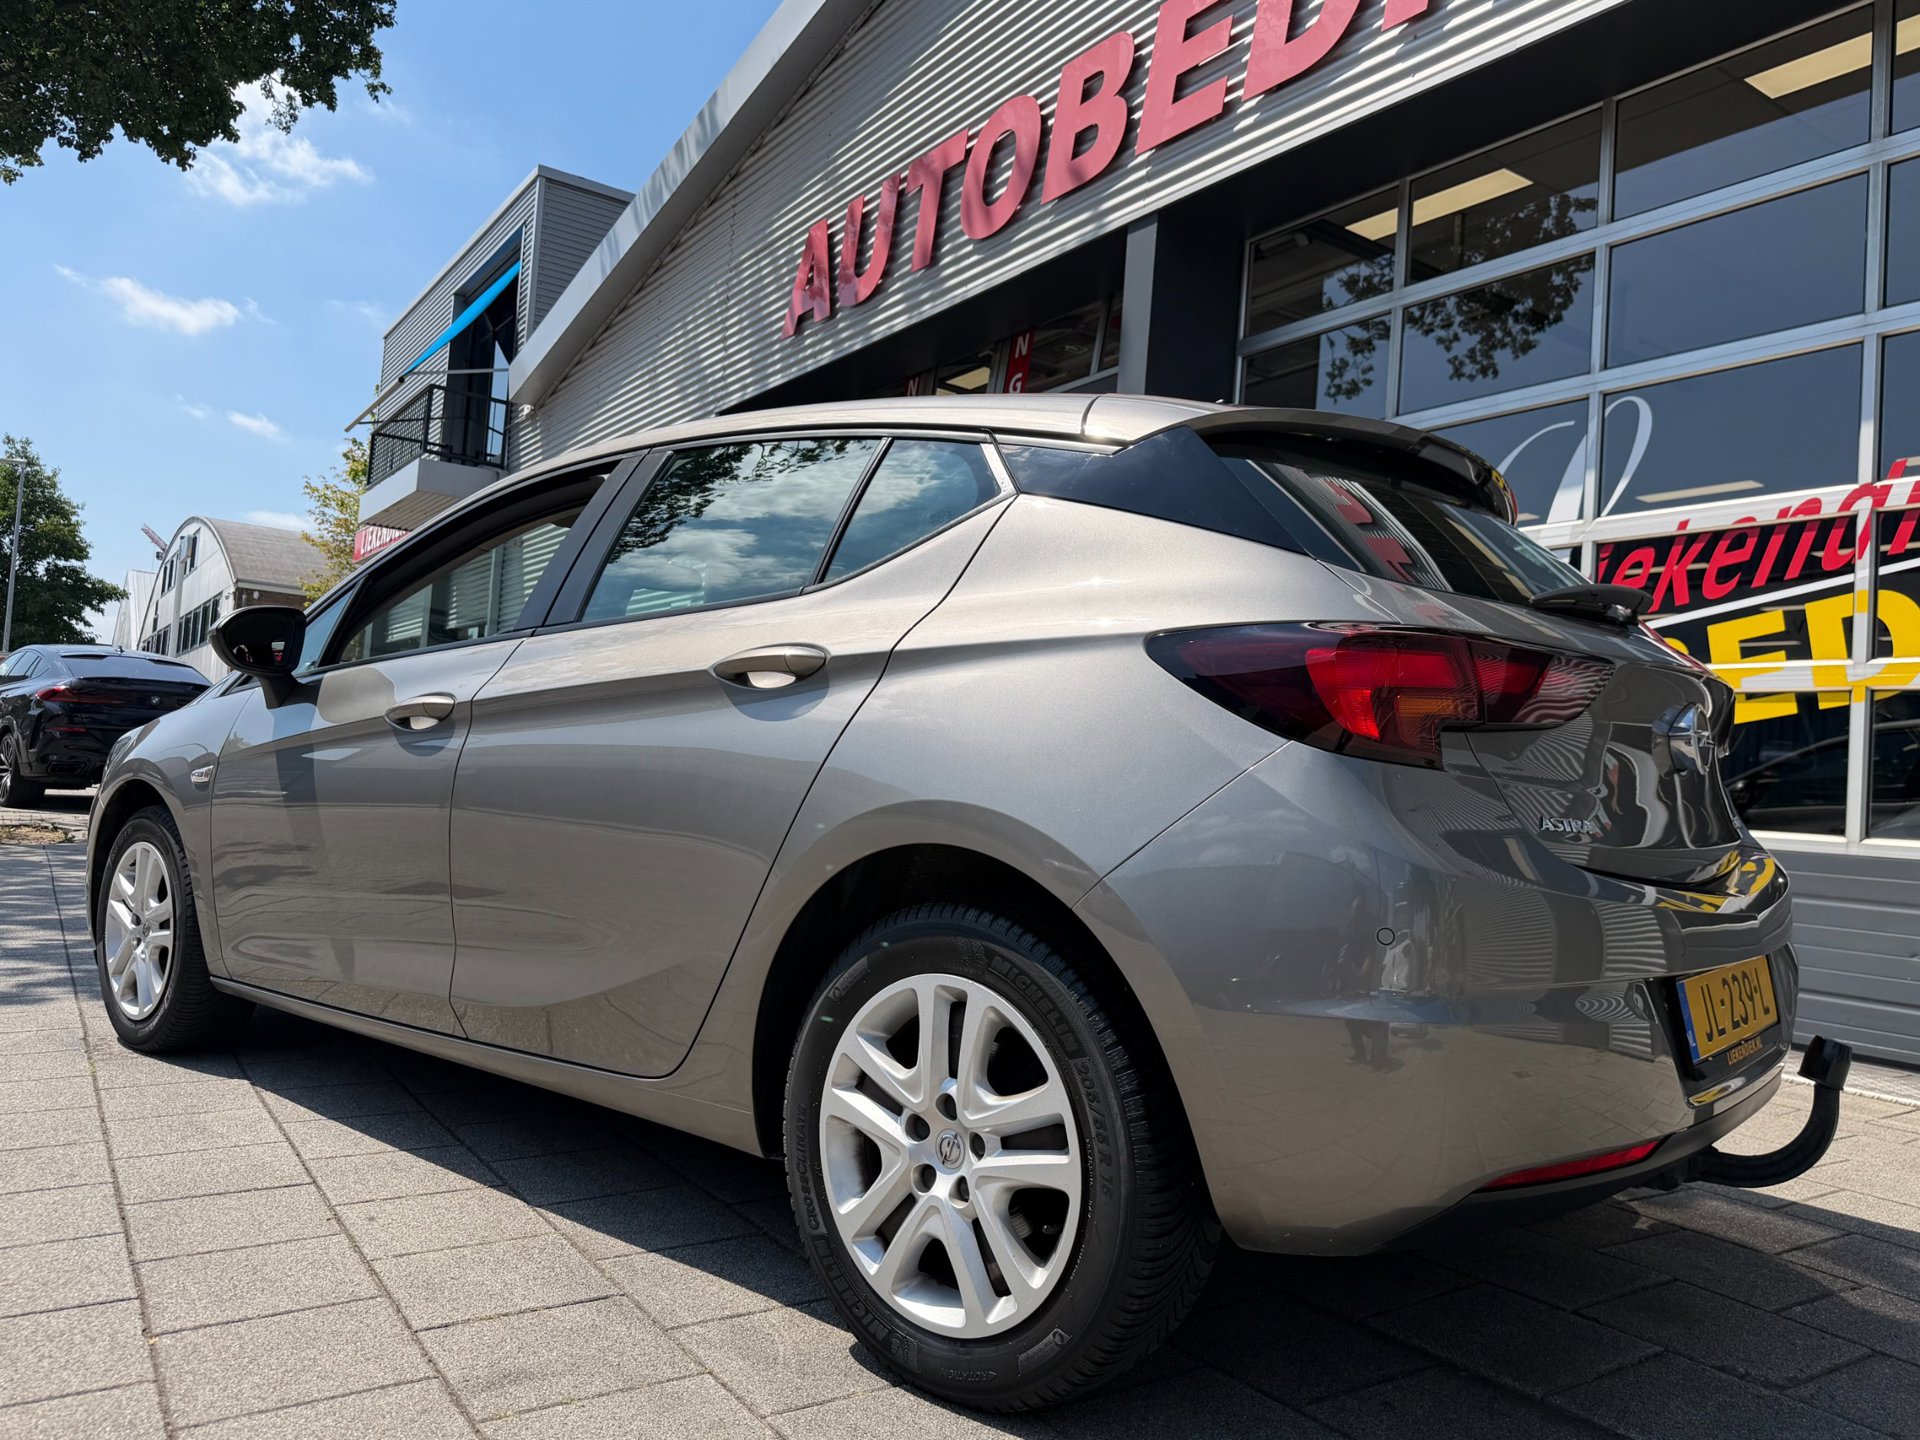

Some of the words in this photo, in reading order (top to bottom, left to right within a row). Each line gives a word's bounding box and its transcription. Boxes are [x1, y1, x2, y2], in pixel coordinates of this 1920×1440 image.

[780, 0, 1428, 340] AUTOBED
[1663, 589, 1920, 725] ED
[1541, 816, 1595, 835] ASTRA
[988, 954, 1080, 1055] MICHELIN
[1700, 967, 1771, 1043] JL-239-L
[814, 1237, 890, 1342] MICHELIN
